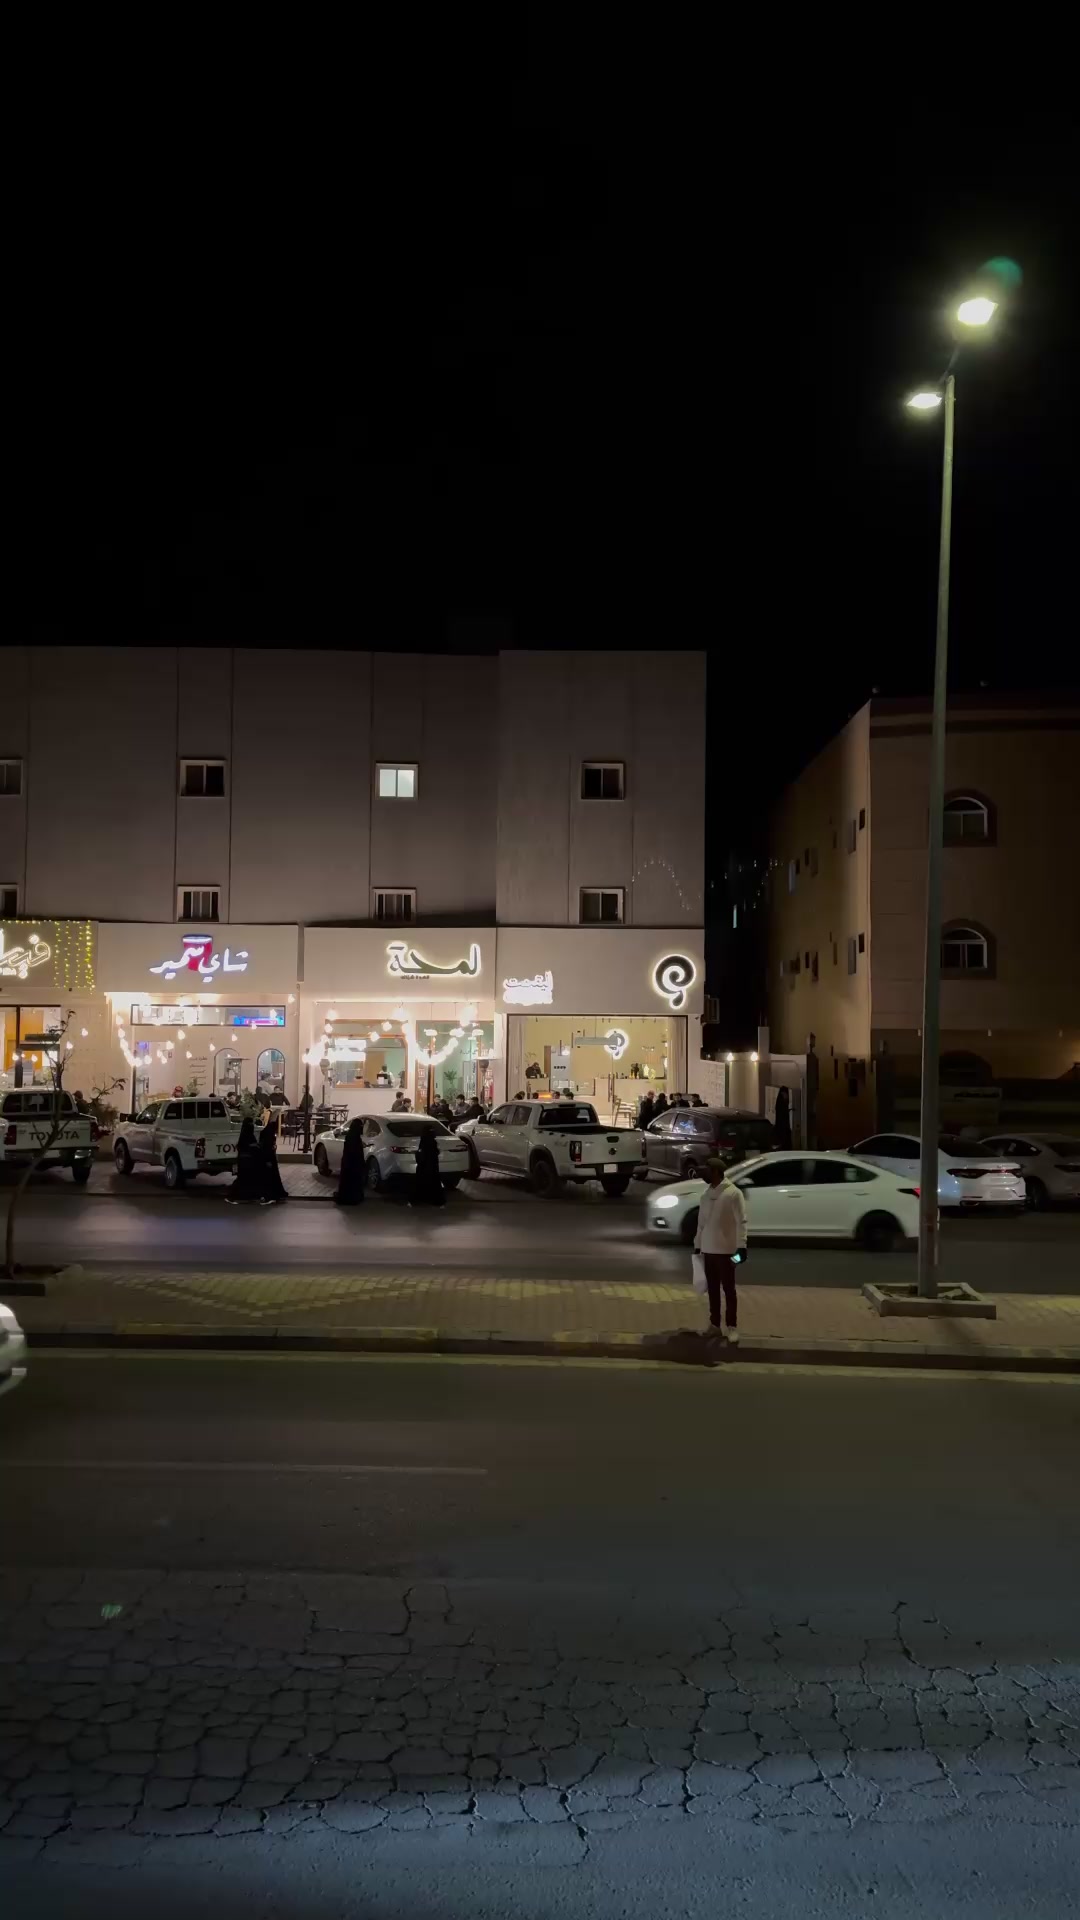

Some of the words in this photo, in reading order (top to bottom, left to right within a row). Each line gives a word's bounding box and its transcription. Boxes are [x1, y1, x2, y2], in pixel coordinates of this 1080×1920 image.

[149, 945, 205, 980] سمير
[198, 946, 249, 983] شاي
[387, 942, 481, 976] لمحة
[215, 1143, 239, 1154] TOY
